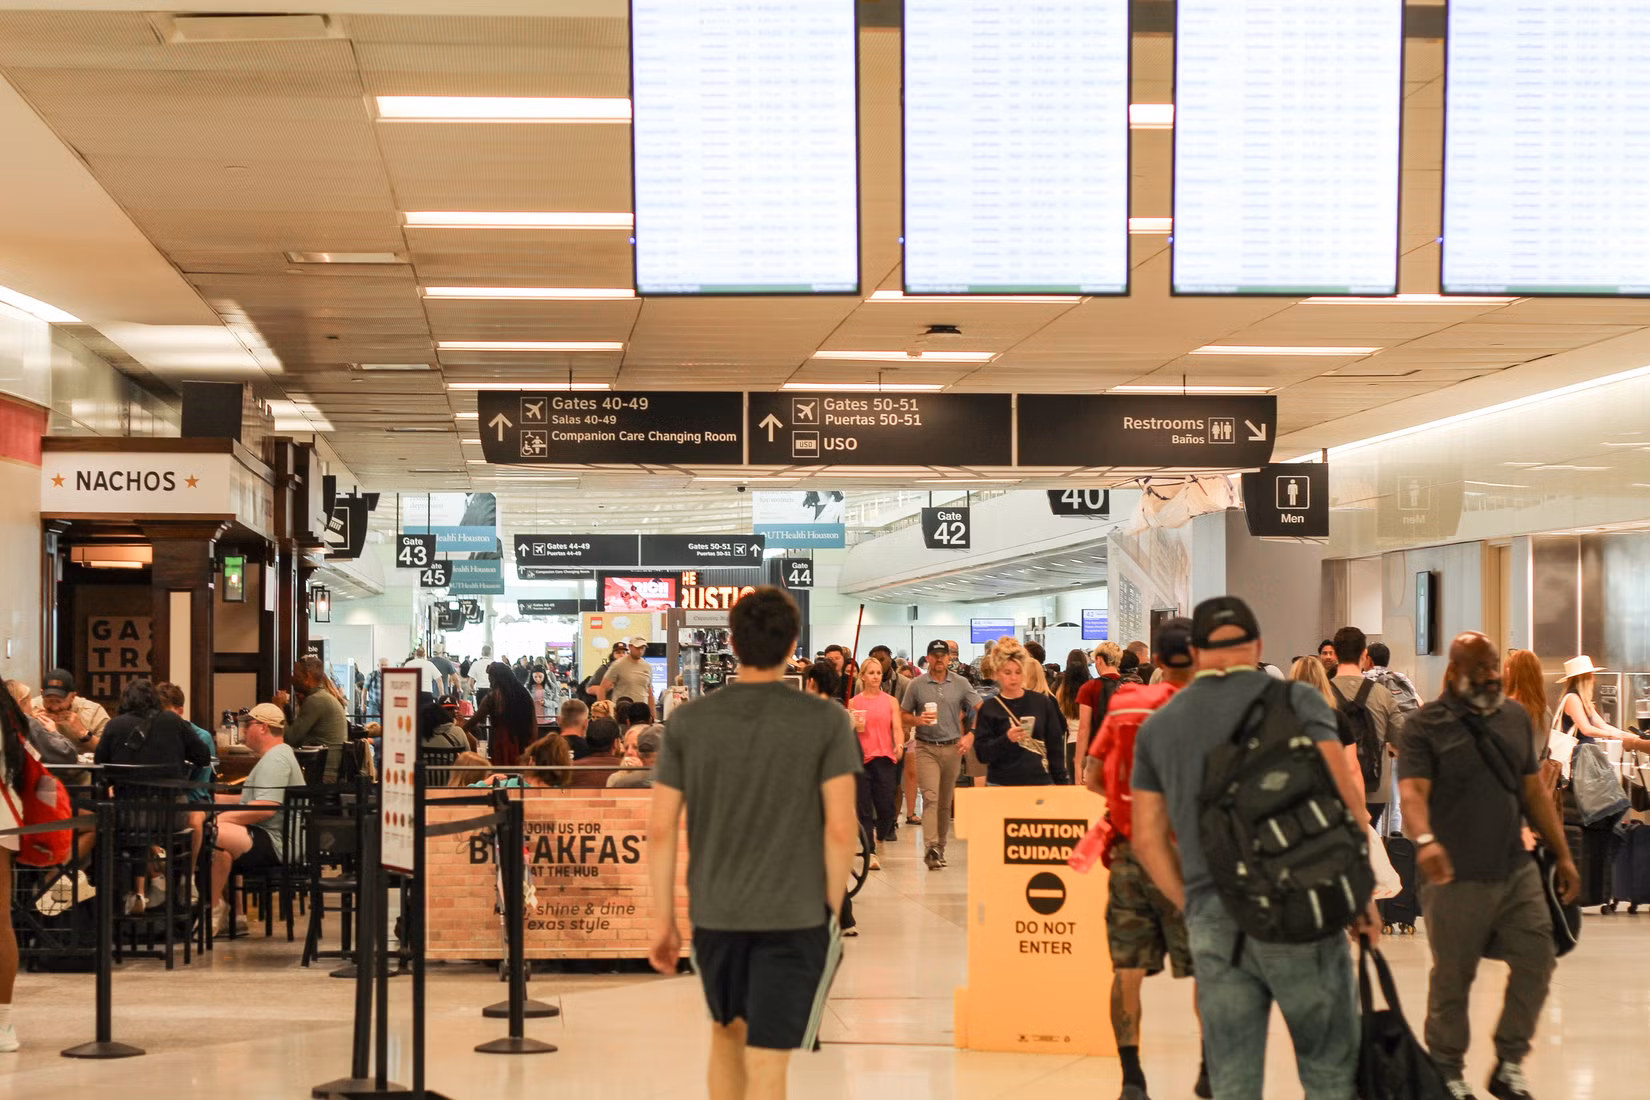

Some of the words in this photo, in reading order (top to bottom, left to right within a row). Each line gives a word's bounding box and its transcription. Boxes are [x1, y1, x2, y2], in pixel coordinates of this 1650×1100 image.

[552, 397, 597, 410] Gates
[602, 397, 649, 410] 40-49
[824, 398, 868, 411] Gates
[873, 398, 919, 411] 50-51
[552, 415, 581, 425] Salas
[584, 415, 617, 425] 40-49
[825, 414, 875, 425] Puertas
[880, 414, 922, 426] 50-51
[1123, 416, 1204, 430] Restrooms
[552, 431, 616, 443] Companion
[619, 432, 645, 442] Care
[648, 431, 701, 444] Changing
[705, 432, 737, 442] Room
[824, 438, 857, 450] USO
[1172, 433, 1205, 444] Baños
[76, 471, 176, 492] NACHOS
[1061, 489, 1105, 510] 40
[937, 511, 962, 521] Gate
[1281, 514, 1305, 524] Men
[458, 534, 490, 542] Houston
[767, 530, 806, 540] UTHealth
[808, 531, 840, 539] Houston
[933, 521, 967, 545] 42
[402, 537, 424, 546] Gate
[398, 546, 427, 566] 43
[422, 569, 446, 586] 45
[682, 571, 697, 586] HE
[788, 569, 812, 585] 44
[681, 586, 756, 609] RUSTI
[92, 620, 152, 641] GA
[526, 823, 555, 834] JOIN
[558, 823, 574, 834] US
[578, 823, 601, 834] FOR
[1006, 823, 1085, 839] CAUTION
[1007, 845, 1074, 860] CUIDAD
[547, 866, 570, 878] THE
[573, 866, 599, 878] HUB
[537, 902, 580, 916] shine
[584, 902, 595, 916] &
[600, 902, 636, 916] dine
[527, 919, 565, 931] exas
[569, 918, 611, 934] style
[1015, 920, 1039, 934] DO
[1043, 921, 1077, 935] NOT
[1019, 940, 1073, 955] ENTER
